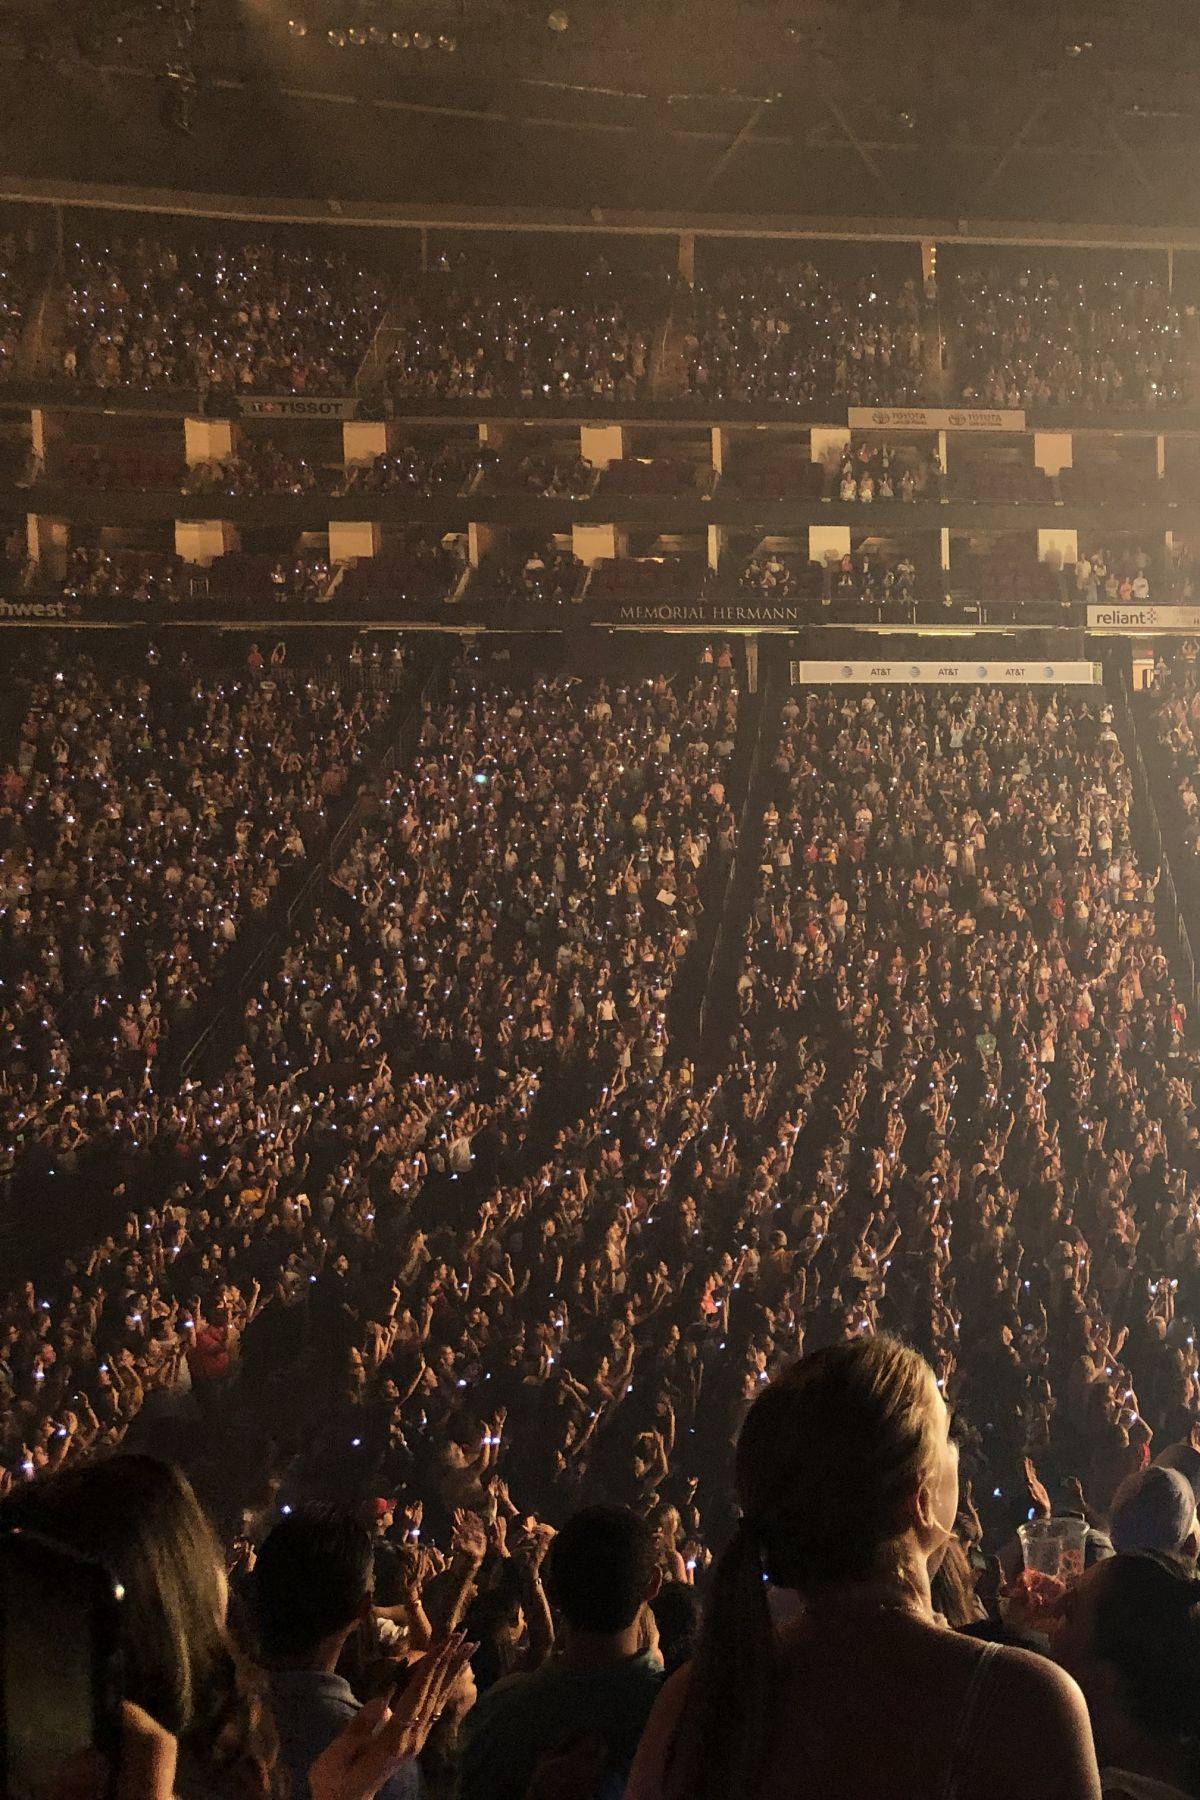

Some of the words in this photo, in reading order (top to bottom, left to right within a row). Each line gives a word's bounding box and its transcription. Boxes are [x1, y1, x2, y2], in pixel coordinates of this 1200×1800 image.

[279, 402, 343, 414] TISSOT
[620, 605, 705, 619] MEMORIAL
[713, 607, 798, 620] HERMANN
[1096, 610, 1146, 625] reliant
[870, 668, 891, 676] AT&T
[938, 668, 958, 676] AT&T
[1005, 668, 1025, 676] AT&T
